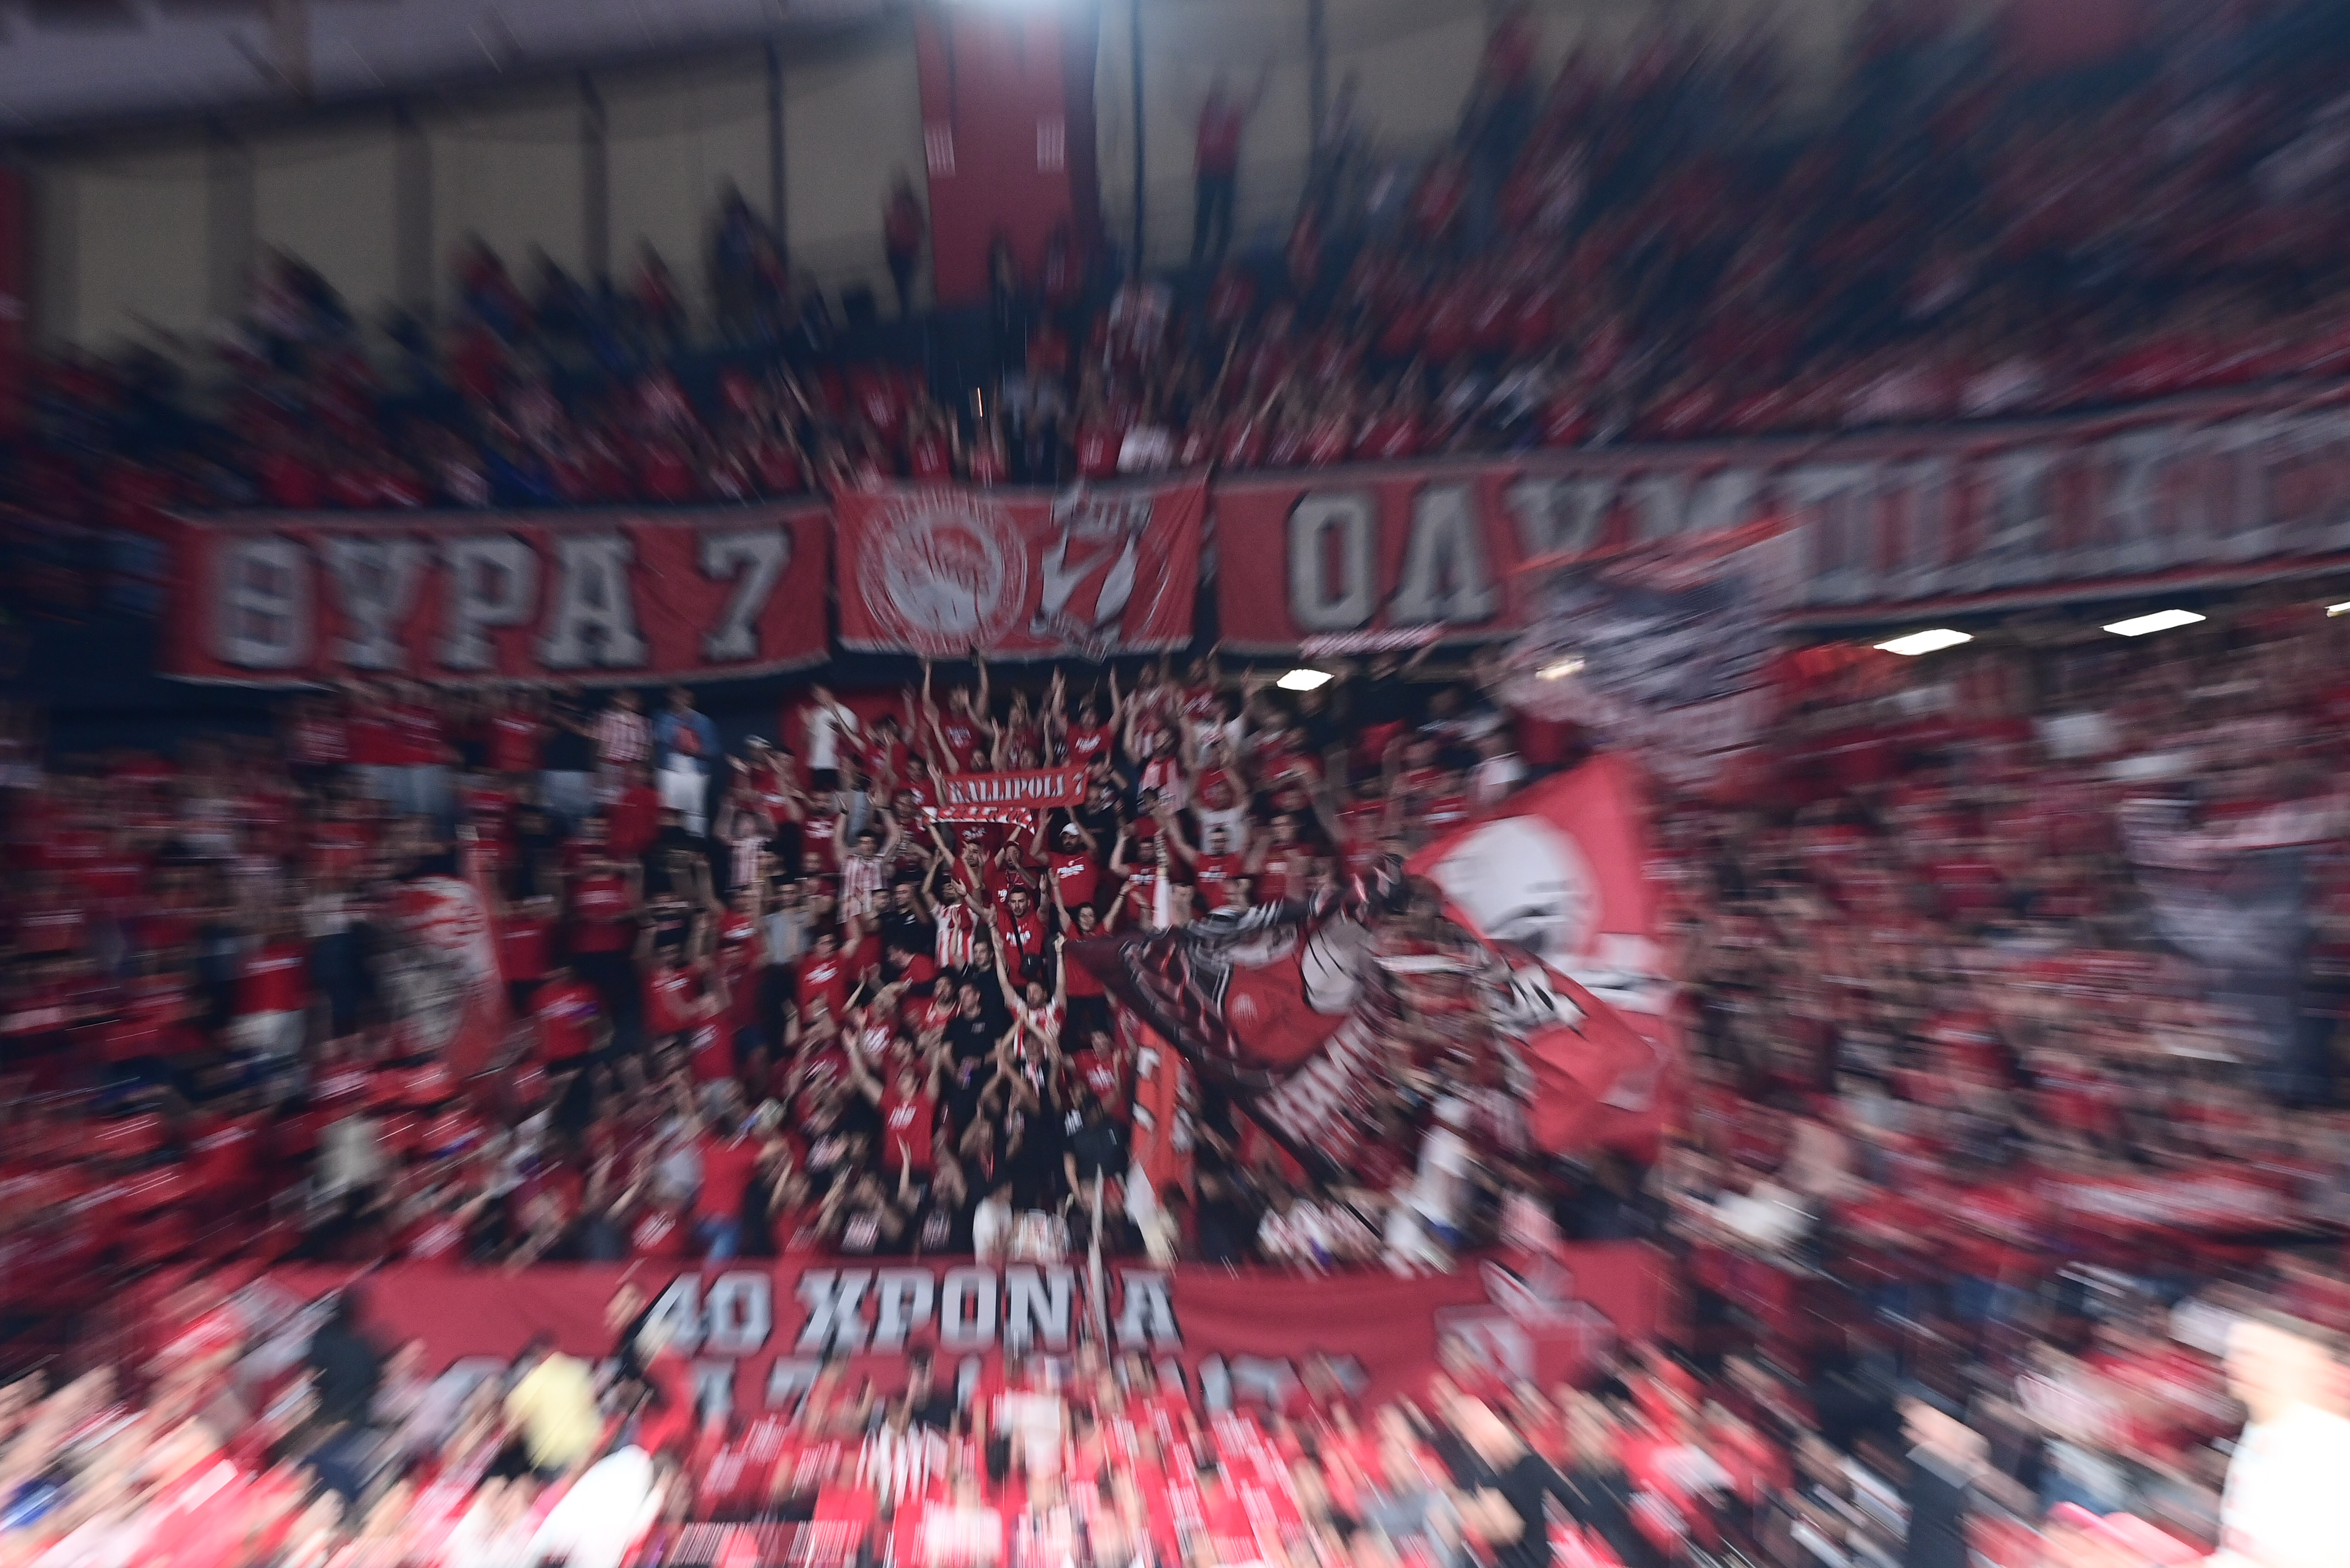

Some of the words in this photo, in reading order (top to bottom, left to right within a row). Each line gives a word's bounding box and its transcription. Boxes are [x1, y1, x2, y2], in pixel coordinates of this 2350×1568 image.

[209, 528, 647, 669] ΘΥΡΑ
[699, 524, 790, 663] 7
[638, 1270, 771, 1355] 40
[794, 1264, 1184, 1354] ΧΡΟΝΑ
